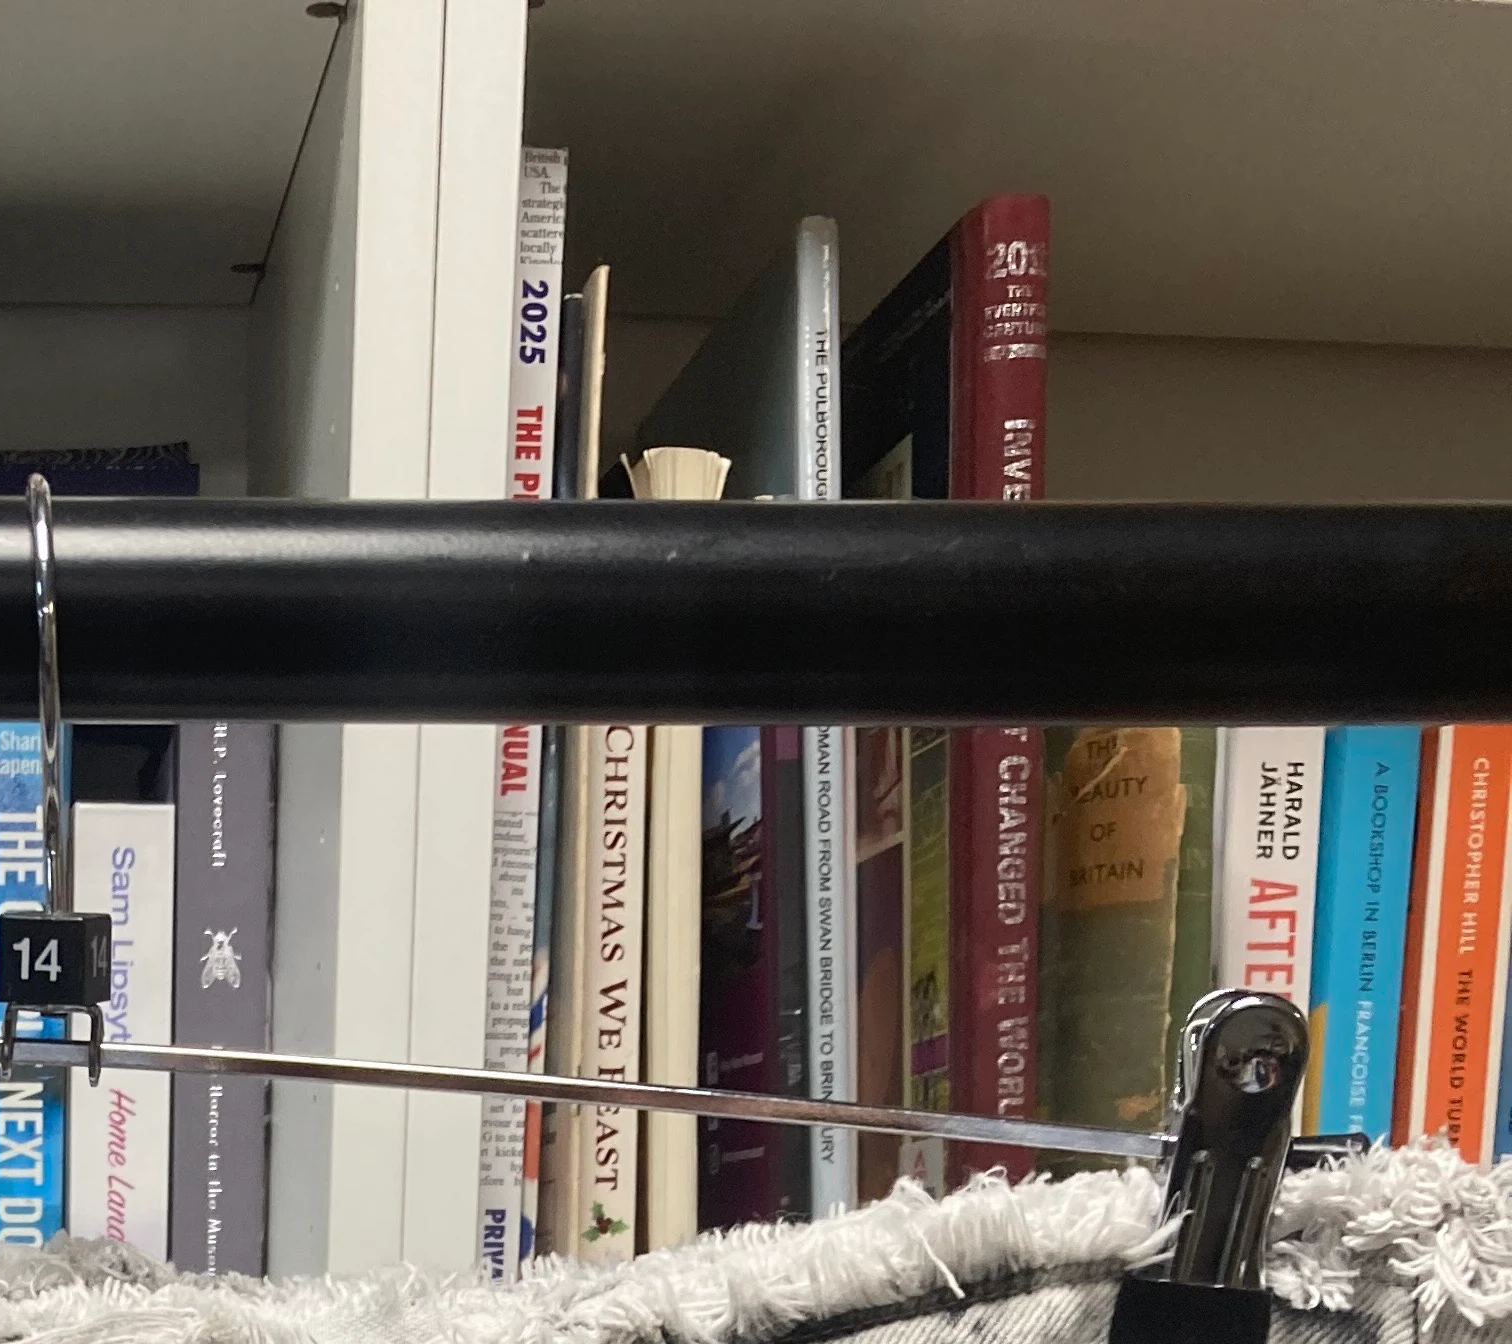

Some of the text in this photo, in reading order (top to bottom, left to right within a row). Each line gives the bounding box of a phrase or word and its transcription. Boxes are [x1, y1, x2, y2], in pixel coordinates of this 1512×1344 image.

[540, 181, 560, 194] The
[520, 279, 549, 366] 2025
[815, 328, 829, 367] THE
[513, 405, 543, 501] THE P
[600, 724, 636, 964] CHRISTMAS
[818, 780, 831, 834] ROAD
[996, 755, 1029, 926] CHANGED
[1089, 821, 1118, 842] OF
[1254, 761, 1280, 861] JÄHNER
[1281, 761, 1306, 862] HARALD
[110, 845, 136, 926] Sam
[818, 838, 831, 893] FROM
[1358, 761, 1390, 993] A BOOKSHOP IN BERLIN
[1457, 756, 1491, 956] CHRISTOPHER HILL
[11, 936, 62, 983] 14
[90, 934, 109, 979] 14
[818, 894, 832, 954] SWAN
[1241, 876, 1302, 999] AFTE
[818, 958, 833, 1028] BRIDGE
[996, 936, 1029, 1005] THE
[1456, 969, 1474, 1007] THE
[596, 979, 630, 1051] WE
[819, 1030, 833, 1056] TO
[1449, 1013, 1471, 1089] WORLD
[997, 1016, 1028, 1124] WORL
[1348, 1000, 1375, 1108] FRANÇOISE
[106, 1087, 137, 1169] Home
[207, 1084, 224, 1147] Horror
[819, 1060, 835, 1166] BRINURY
